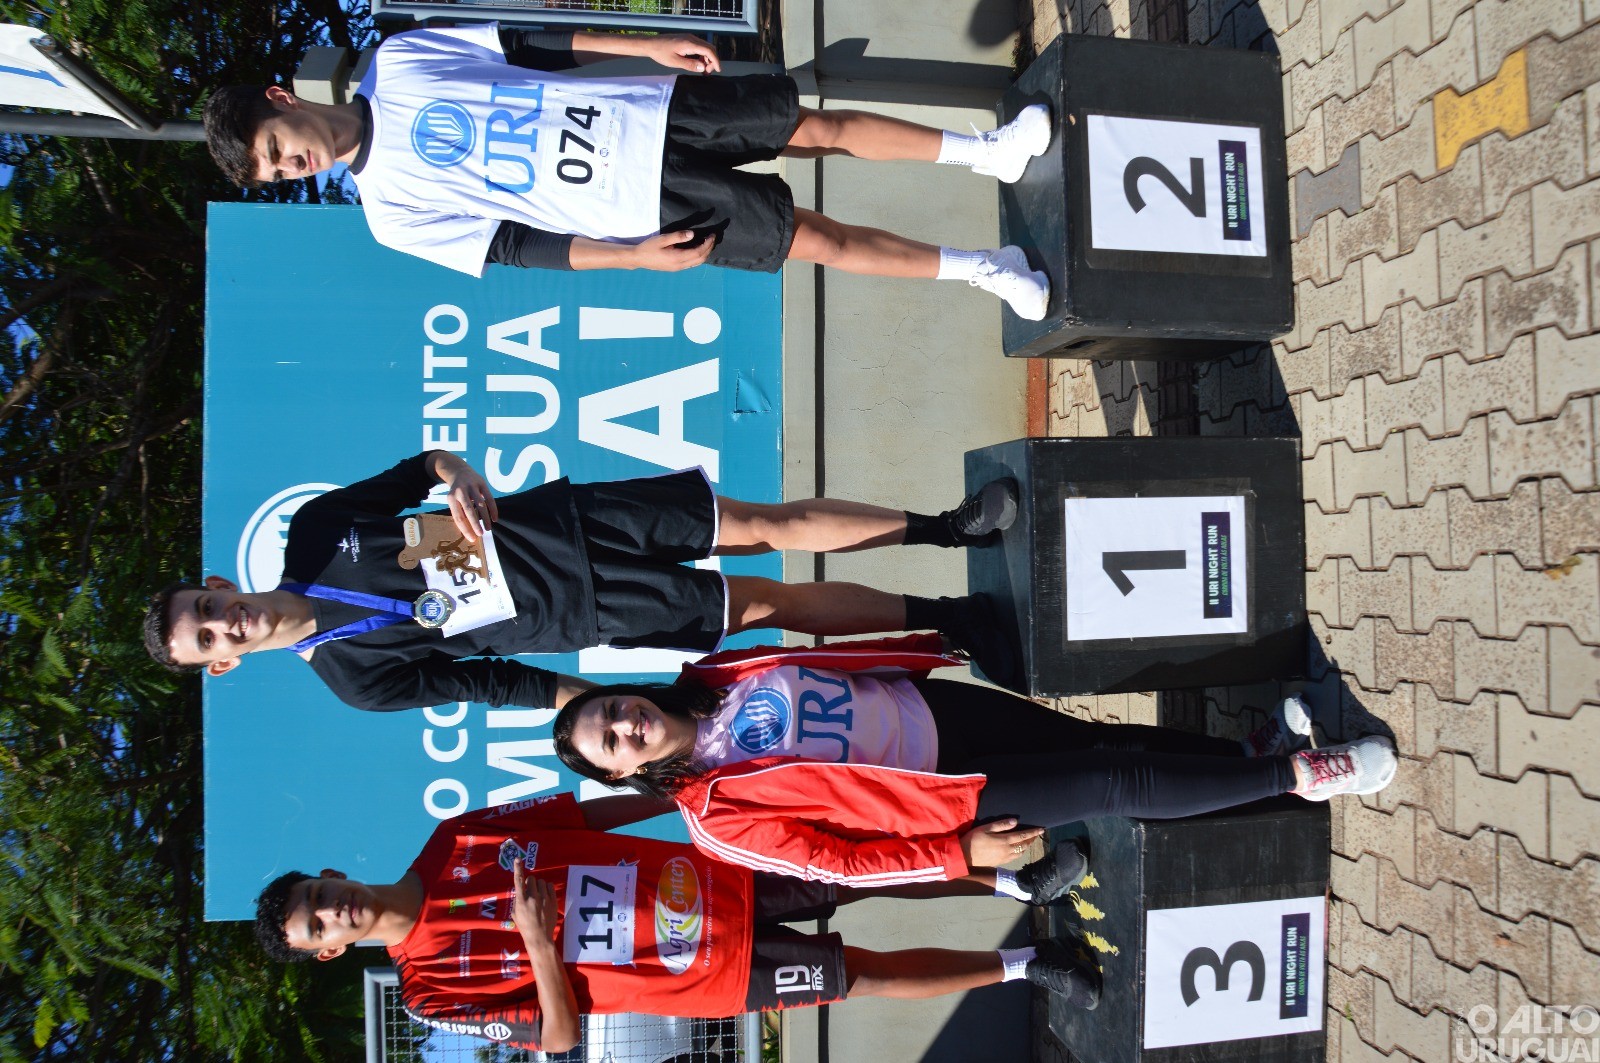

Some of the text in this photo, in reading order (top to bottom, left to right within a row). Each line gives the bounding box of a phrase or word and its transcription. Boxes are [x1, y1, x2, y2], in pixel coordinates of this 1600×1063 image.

[484, 81, 544, 195] URI
[556, 106, 601, 184] 074
[1225, 152, 1236, 171] RUN
[1123, 156, 1206, 218] 2
[1226, 174, 1237, 202] NIGHT
[1227, 205, 1238, 220] URI
[484, 306, 561, 494] SUA
[1207, 525, 1218, 545] RUN
[1102, 550, 1186, 597] 1
[1208, 548, 1218, 578] NIGHT
[1208, 581, 1219, 596] URI
[796, 665, 853, 763] URI
[423, 778, 470, 820] O
[527, 843, 537, 868] AFUCS
[578, 874, 615, 950] 117
[707, 906, 713, 915] no
[706, 916, 714, 946] parceiro
[1287, 927, 1297, 946] RUN
[1180, 941, 1266, 1008] 3
[1287, 950, 1297, 979] NIGHT
[775, 965, 810, 994] 19
[1286, 982, 1296, 997] URI
